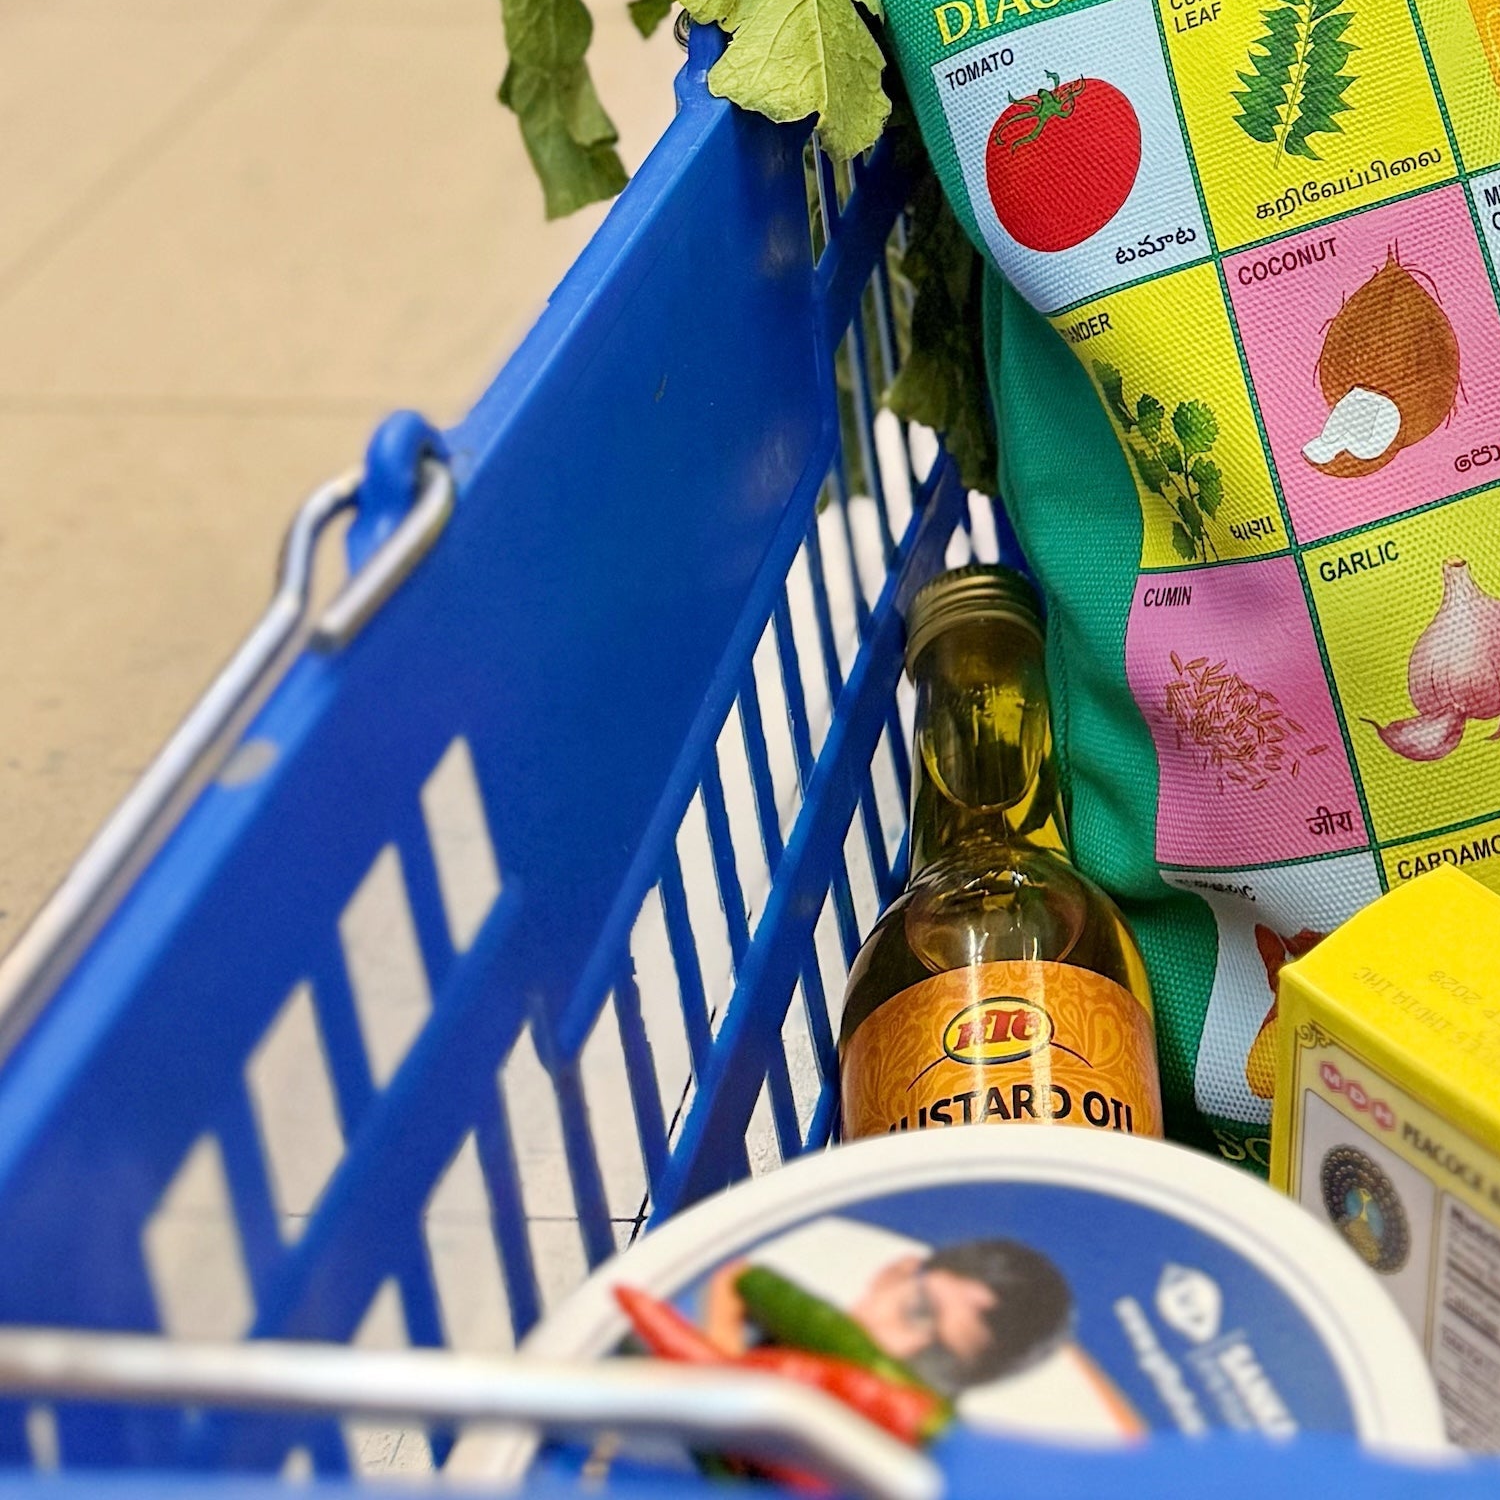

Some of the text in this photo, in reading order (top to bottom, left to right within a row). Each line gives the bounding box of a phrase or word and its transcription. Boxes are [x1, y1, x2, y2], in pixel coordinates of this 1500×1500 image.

[1173, 2, 1223, 34] LEAF
[944, 47, 1016, 92] TOMATO
[1255, 147, 1443, 221] கறிவேப்பிலை
[1238, 238, 1340, 288] COCONUT
[1318, 540, 1401, 584] GARLIC
[1143, 585, 1193, 609] CUMIN
[1305, 806, 1354, 838] जीरा
